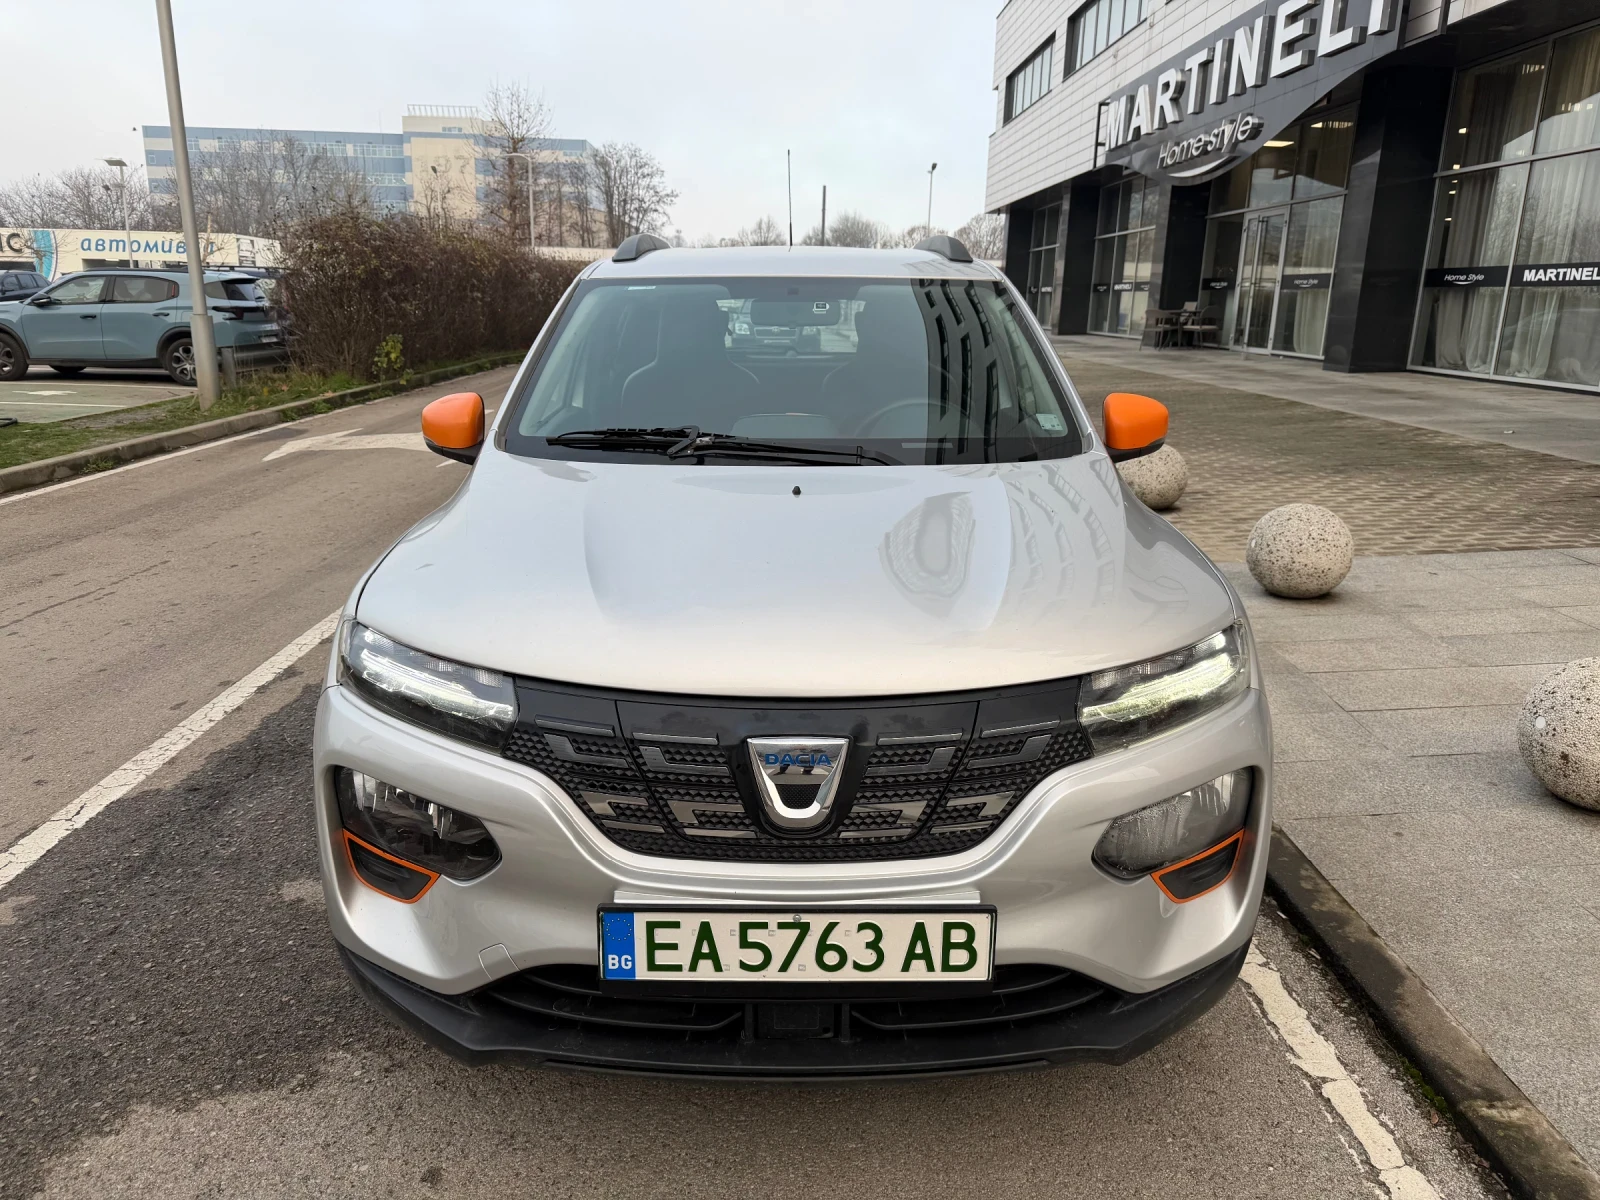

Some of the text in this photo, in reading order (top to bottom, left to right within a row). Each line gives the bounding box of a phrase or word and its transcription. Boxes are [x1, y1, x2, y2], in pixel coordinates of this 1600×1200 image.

[1157, 134, 1206, 169] Home
[80, 237, 215, 254] автомива
[764, 753, 832, 767] DACIA
[646, 920, 978, 972] EA 5763 AB
[608, 955, 632, 969] BG
